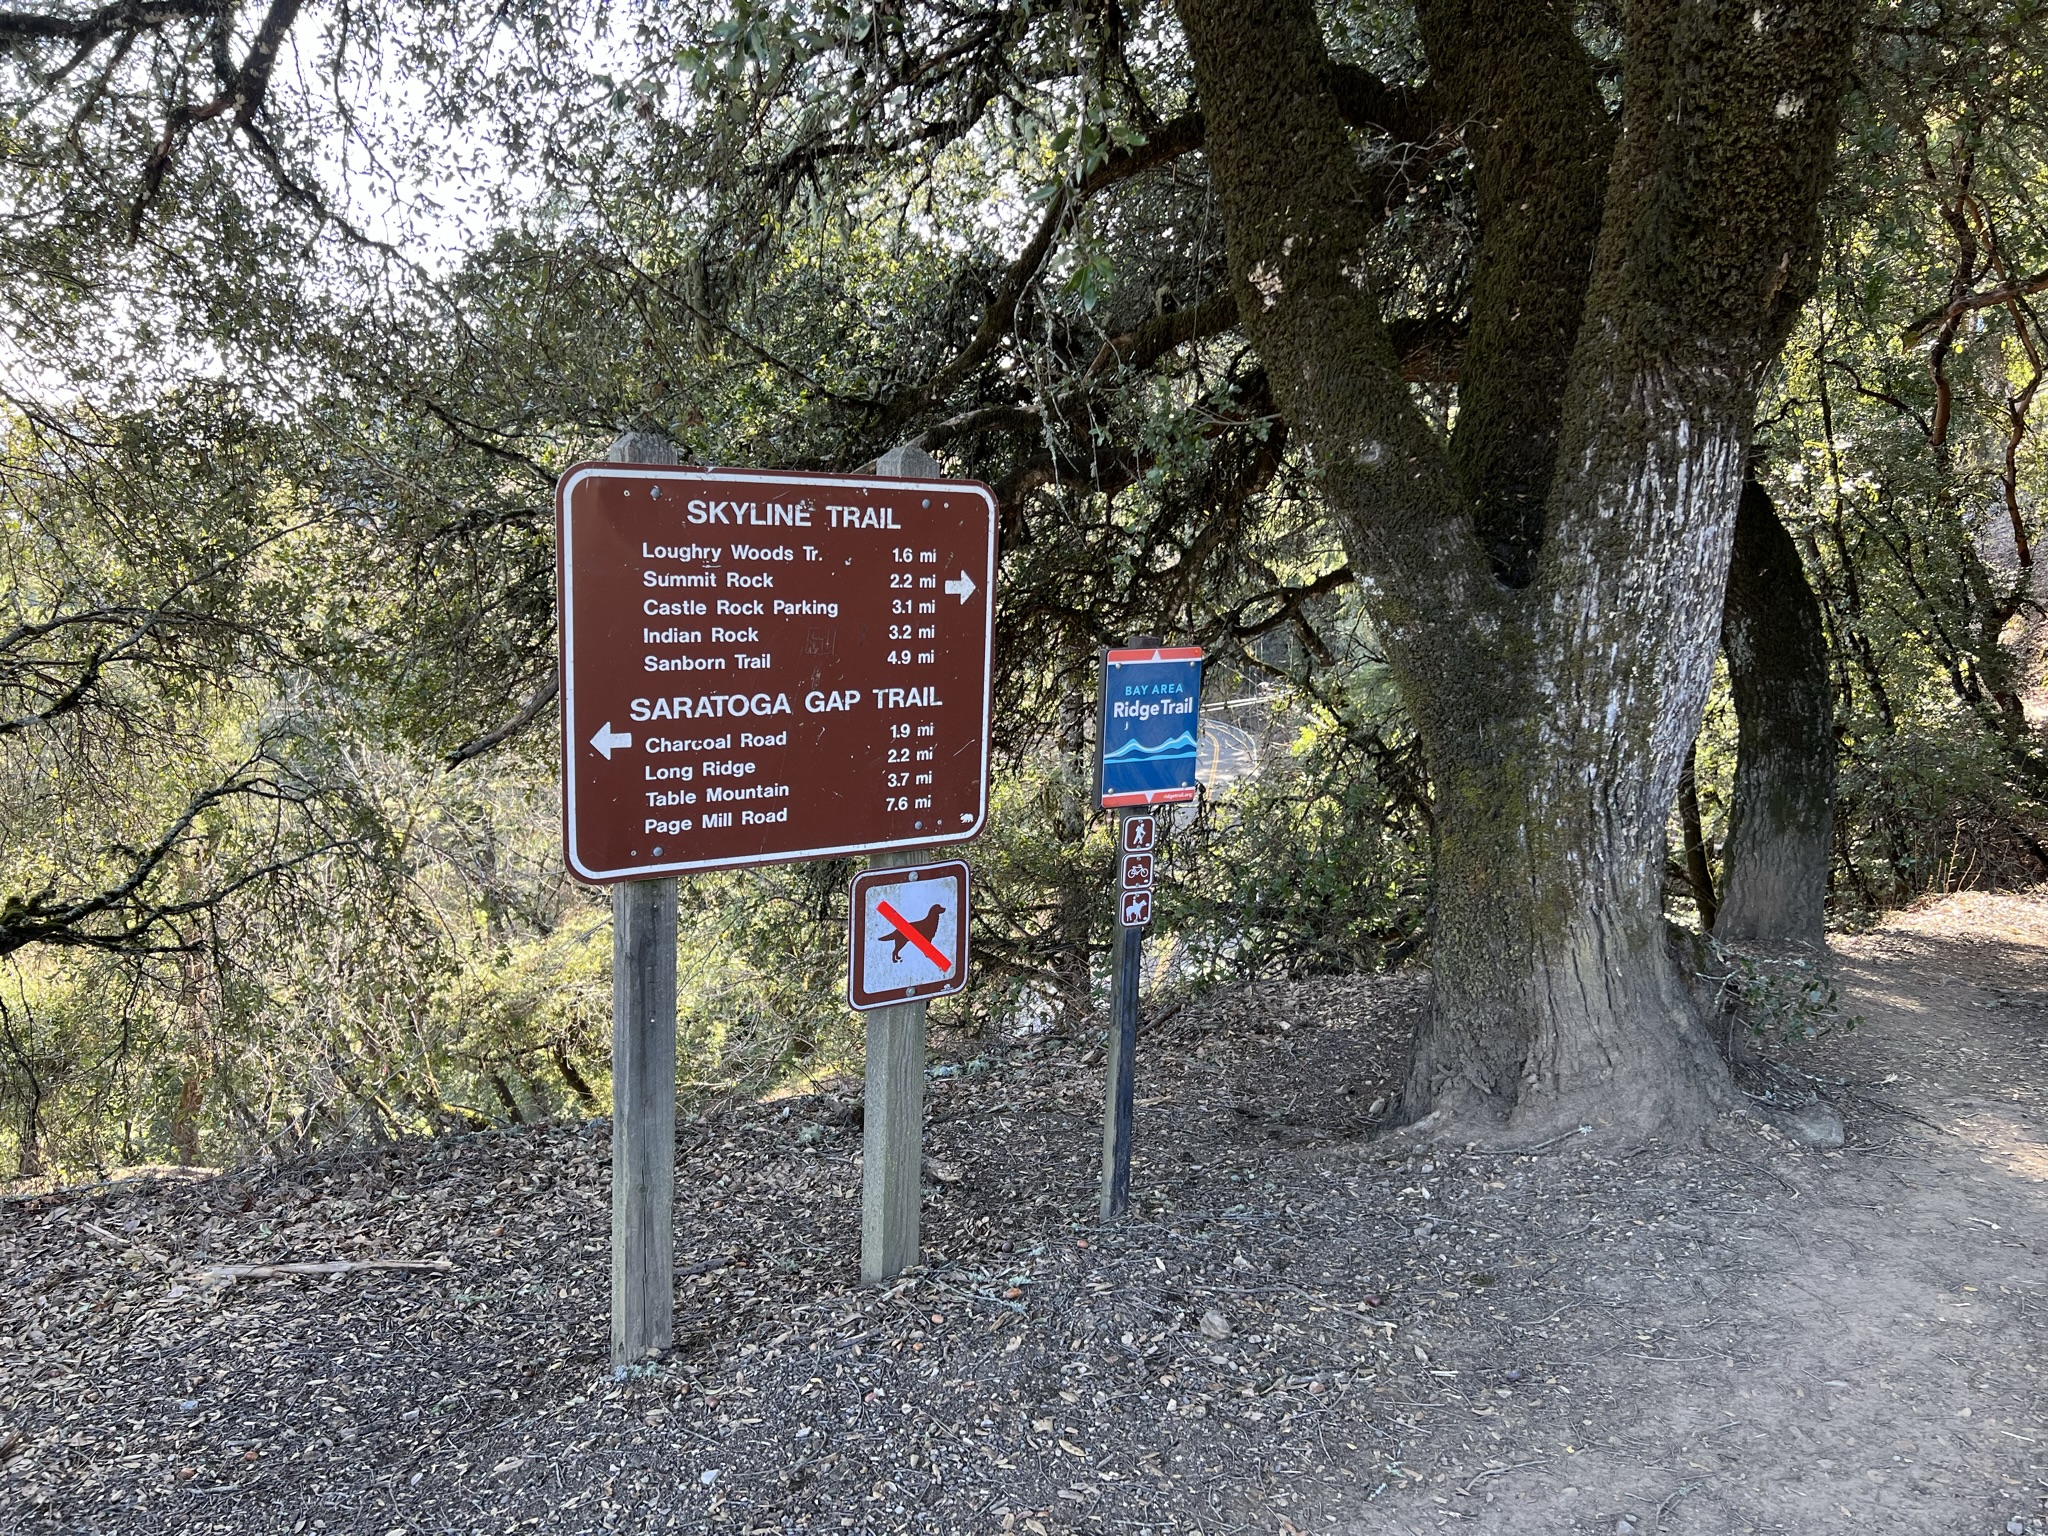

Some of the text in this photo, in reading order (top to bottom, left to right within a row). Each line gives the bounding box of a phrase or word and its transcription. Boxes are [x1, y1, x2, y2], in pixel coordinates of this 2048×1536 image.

[687, 500, 901, 529] SKYLINE TRAIL
[642, 543, 823, 561] Loughry Woods Tr.
[892, 547, 936, 562] 1.6 mi
[643, 572, 773, 588] Summit Rock
[890, 574, 936, 588] 2.2 mi
[643, 600, 839, 617] Castle Rock Parking
[892, 600, 935, 614] 3.1 mi
[643, 628, 758, 643] Indian Rock
[889, 625, 935, 639] 3.2 mi
[644, 655, 770, 671] Sanborn Trail
[887, 650, 934, 665] 4.9 mi
[1126, 684, 1182, 695] BAY AREA
[630, 687, 942, 721] SARATOGA GAP TRAIL
[1114, 698, 1192, 720] Ridge Trail
[890, 724, 934, 738] 1.9 mi
[645, 732, 787, 753] Charcoal Road
[887, 748, 933, 762] 2.2 mi
[645, 760, 755, 781] Long Ridge
[887, 772, 932, 786] 3.7 mi
[646, 785, 789, 807] Table Mountain
[886, 795, 931, 811] 7.6 mi
[644, 809, 787, 834] Page Mill Road
